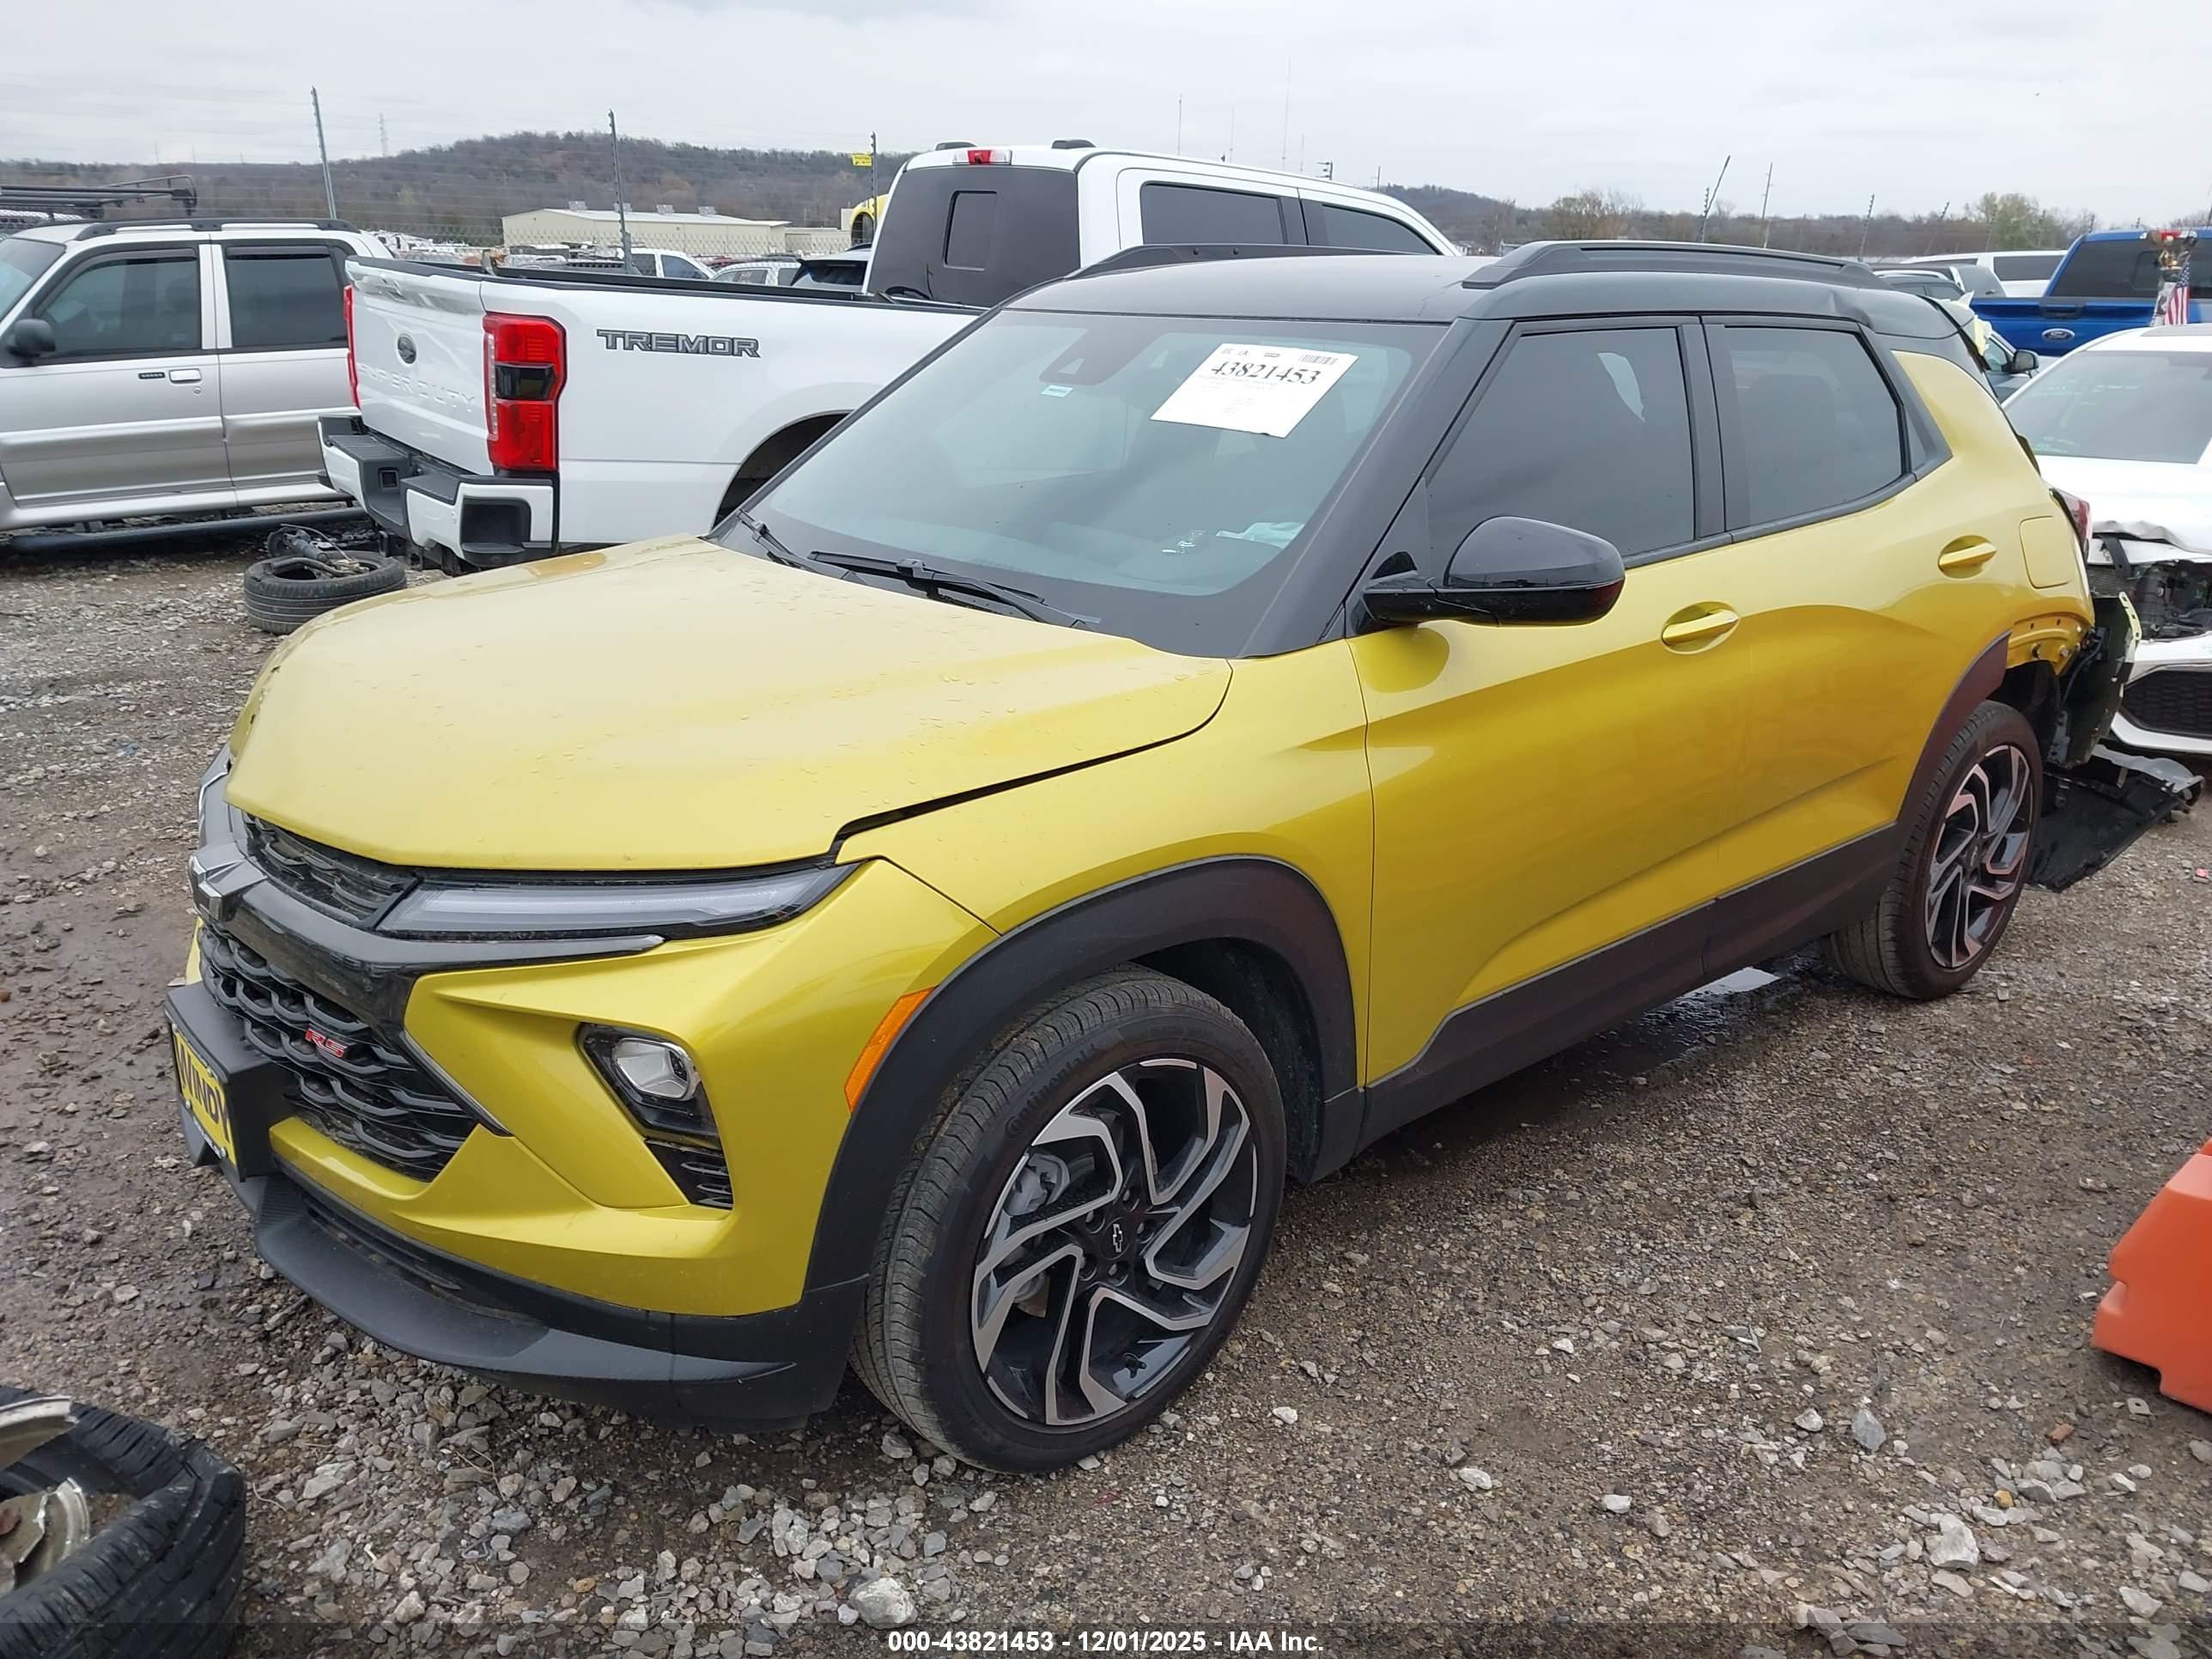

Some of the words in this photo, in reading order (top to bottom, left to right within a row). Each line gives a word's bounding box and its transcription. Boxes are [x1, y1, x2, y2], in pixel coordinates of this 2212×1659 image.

[596, 328, 761, 358] TREMOR
[1211, 361, 1322, 384] 43821453
[305, 1028, 347, 1058] RS
